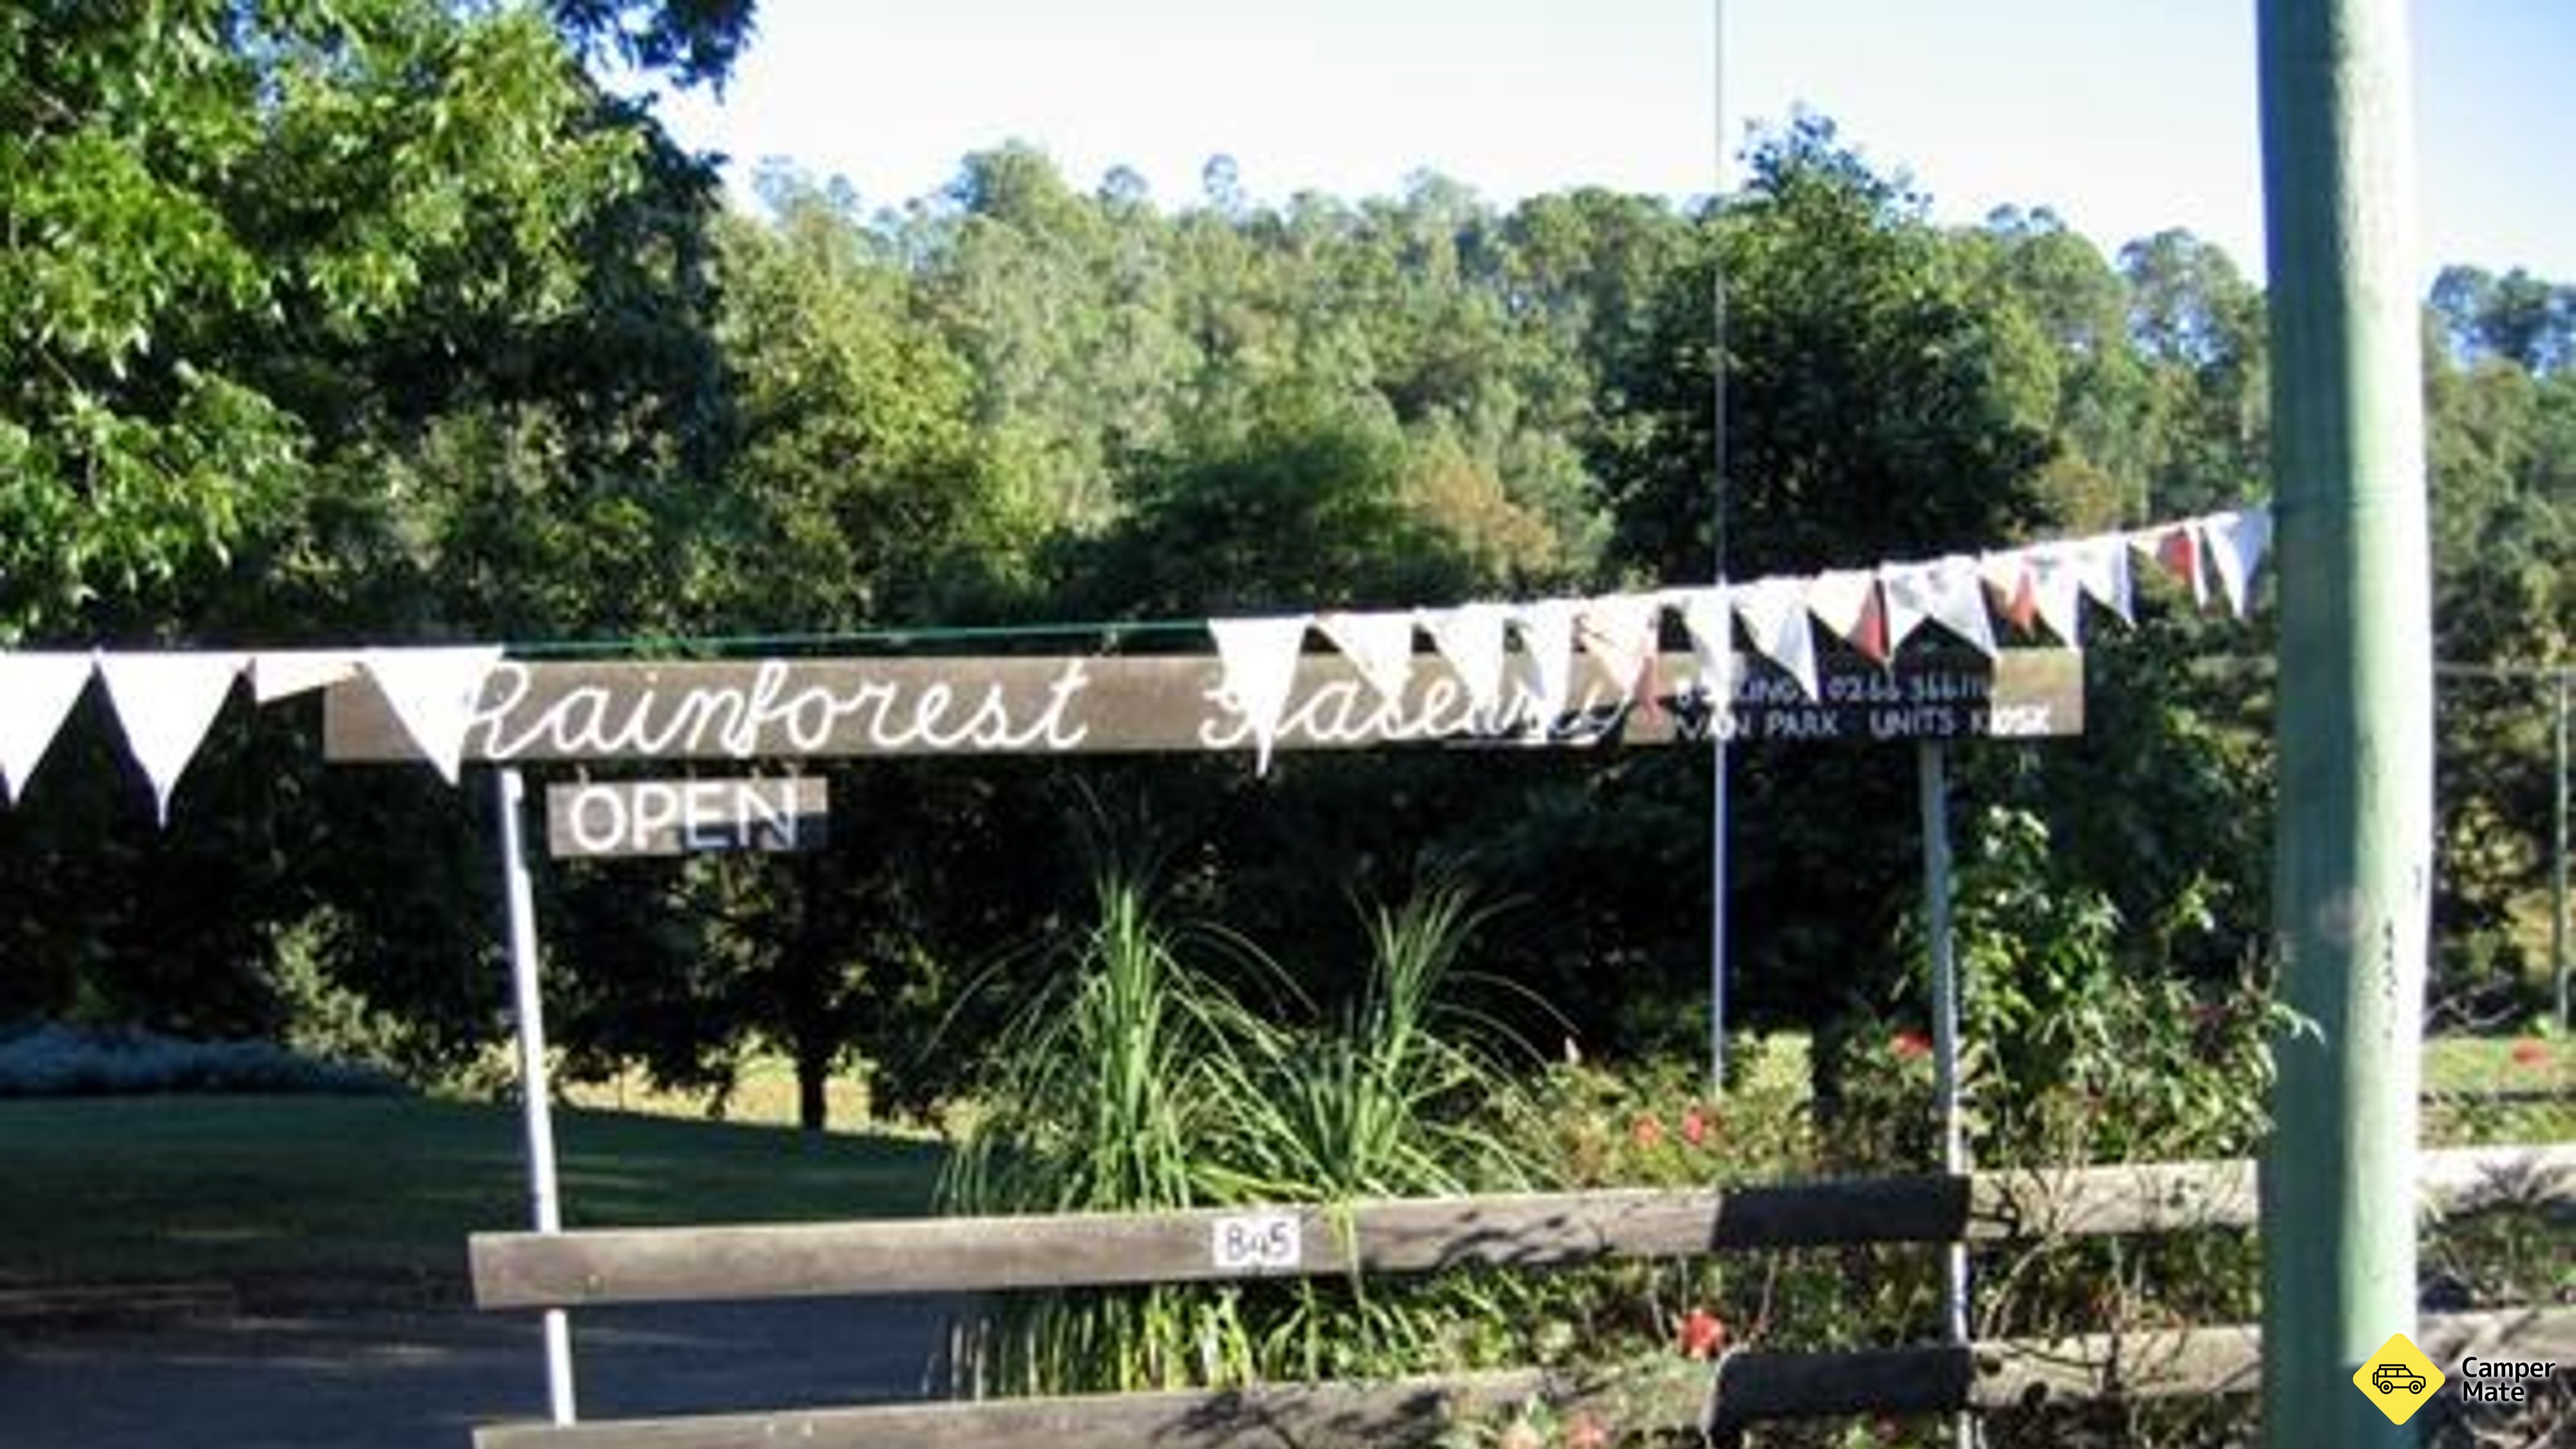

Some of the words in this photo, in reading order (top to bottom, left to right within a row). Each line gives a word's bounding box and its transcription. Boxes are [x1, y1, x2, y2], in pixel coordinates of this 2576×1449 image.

[471, 658, 1088, 759] Rainforest
[1765, 710, 1840, 739] PARK
[1869, 707, 1955, 740] UNITS
[1971, 703, 2050, 735] KIOSK
[571, 785, 797, 851] OPEN
